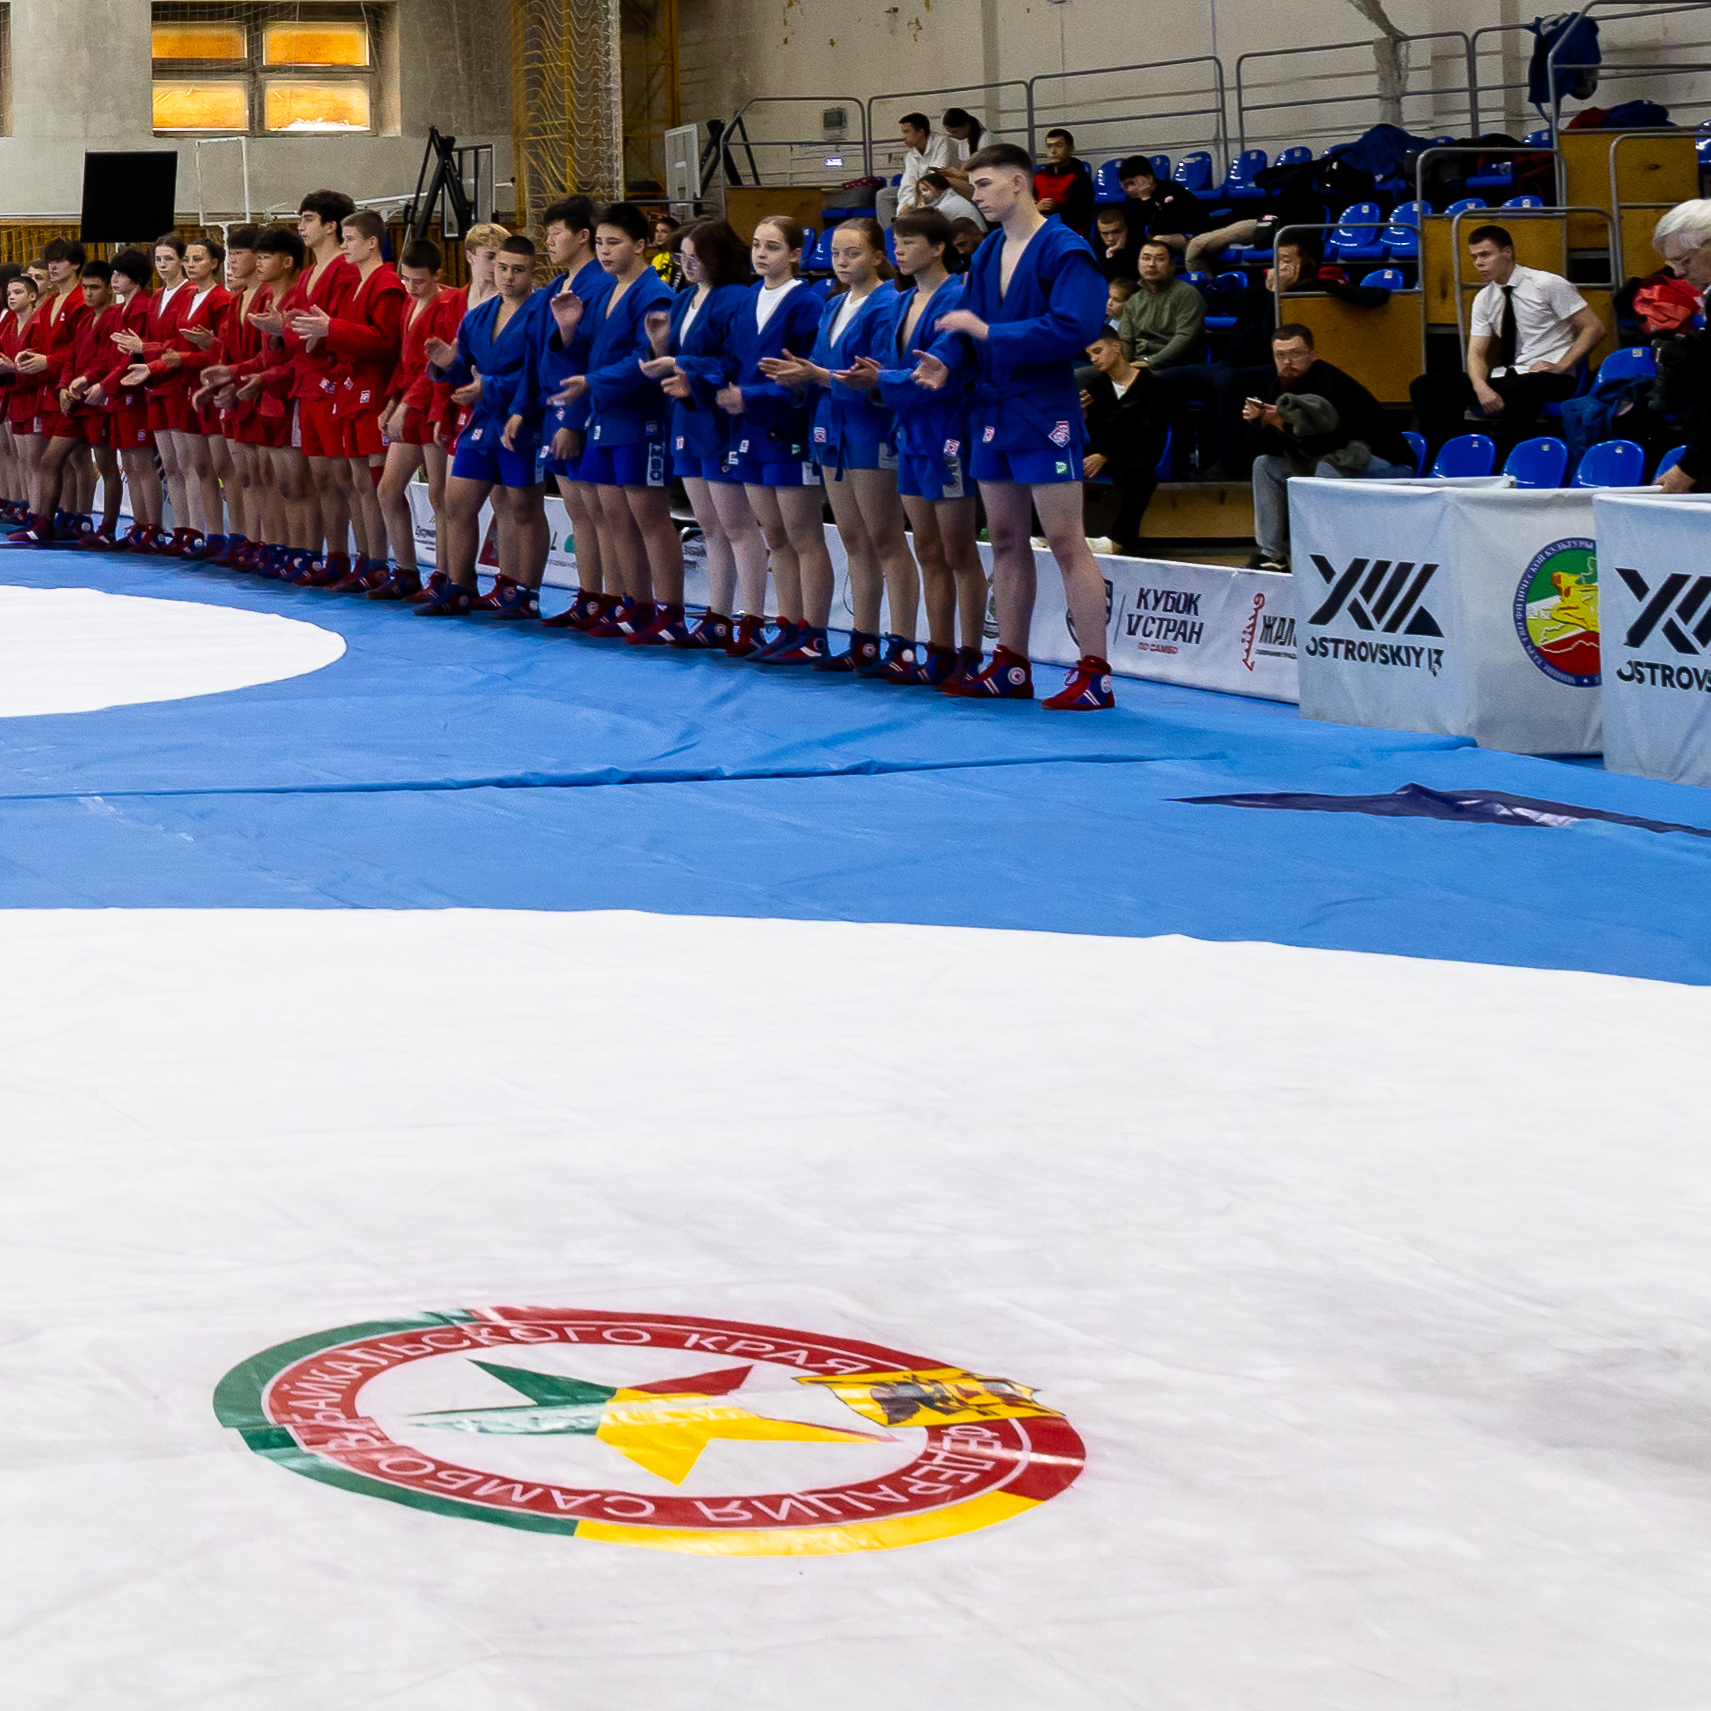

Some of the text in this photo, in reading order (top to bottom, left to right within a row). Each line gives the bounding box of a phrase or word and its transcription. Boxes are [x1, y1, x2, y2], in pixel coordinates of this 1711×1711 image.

[1135, 587, 1202, 616] КУБОК
[683, 1331, 874, 1375] КРАЯ
[377, 1455, 656, 1518] САМБО
[694, 1424, 1003, 1522] ФЕДЕРАЦИЯ
